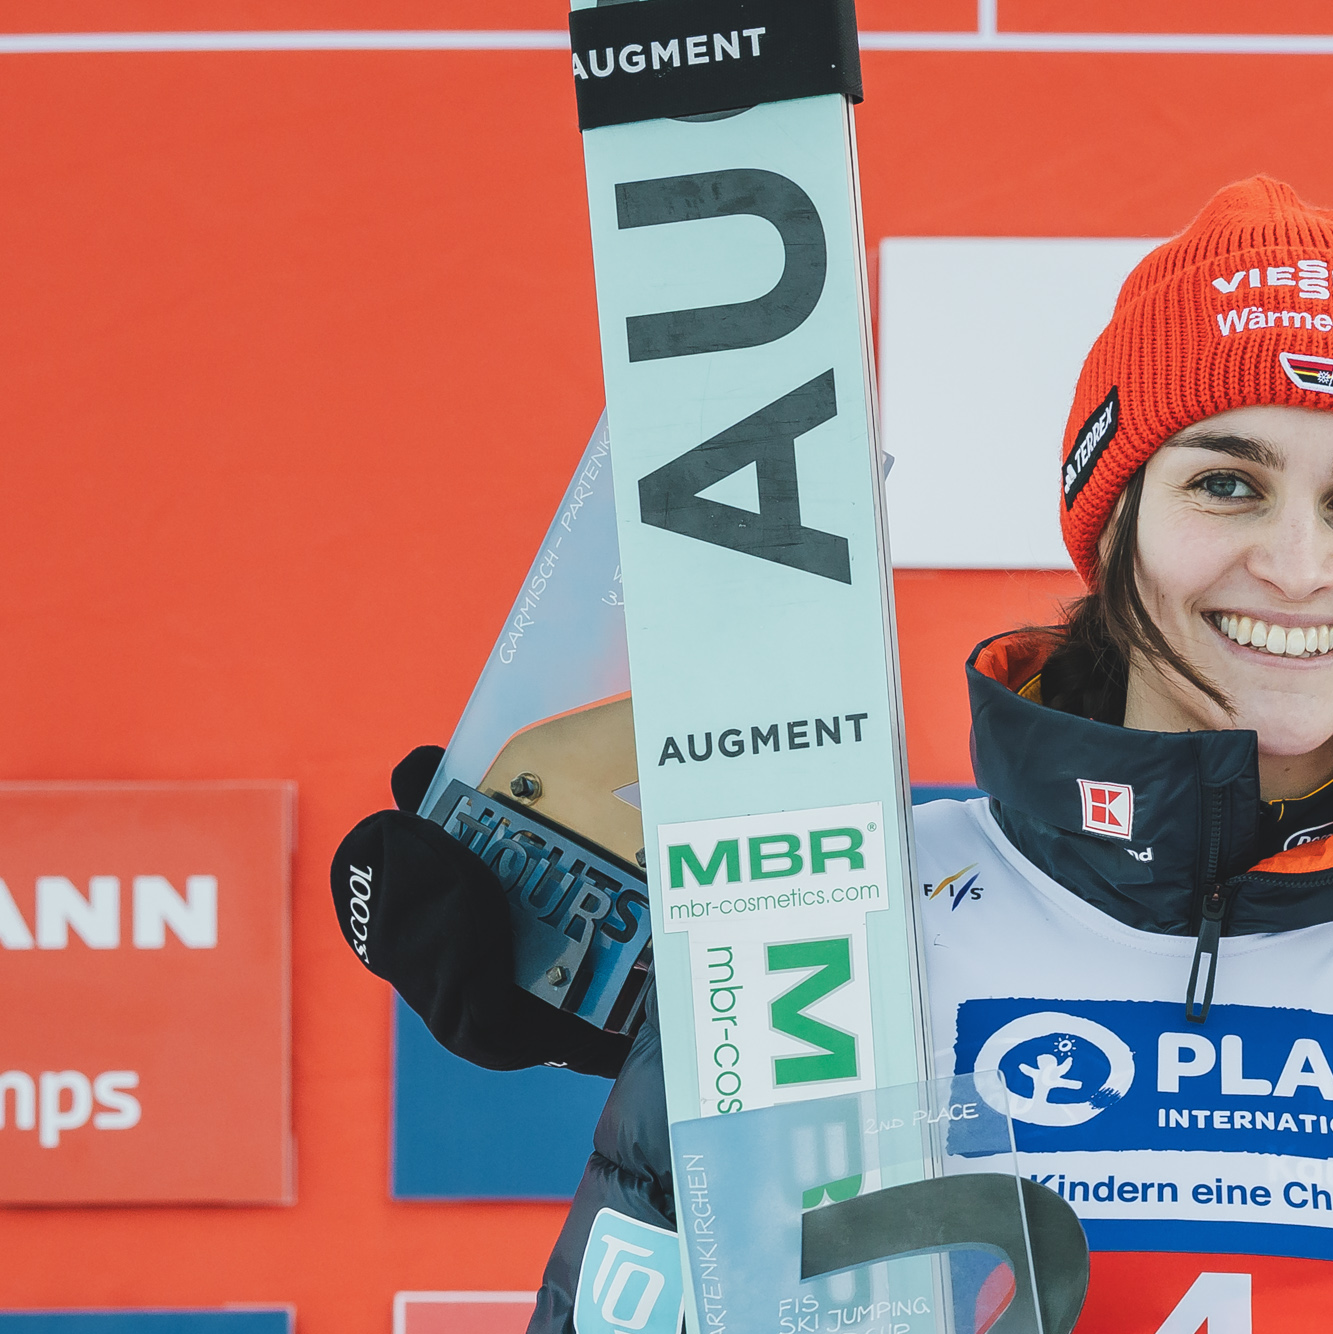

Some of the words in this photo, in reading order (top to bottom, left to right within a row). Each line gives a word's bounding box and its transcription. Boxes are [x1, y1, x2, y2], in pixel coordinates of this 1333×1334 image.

[570, 27, 767, 80] AUGMENT
[1074, 400, 1114, 474] TERREX
[657, 712, 869, 767] AUGMENT
[667, 827, 866, 890] MBR
[670, 884, 880, 919] mbr-cosmetics.com
[923, 879, 984, 903] FIS
[864, 1117, 906, 1136] 2ND
[912, 1102, 980, 1127] PLACE
[1196, 1177, 1274, 1206] eine
[778, 1294, 820, 1318] FIS
[826, 1296, 931, 1333] JUMPING
